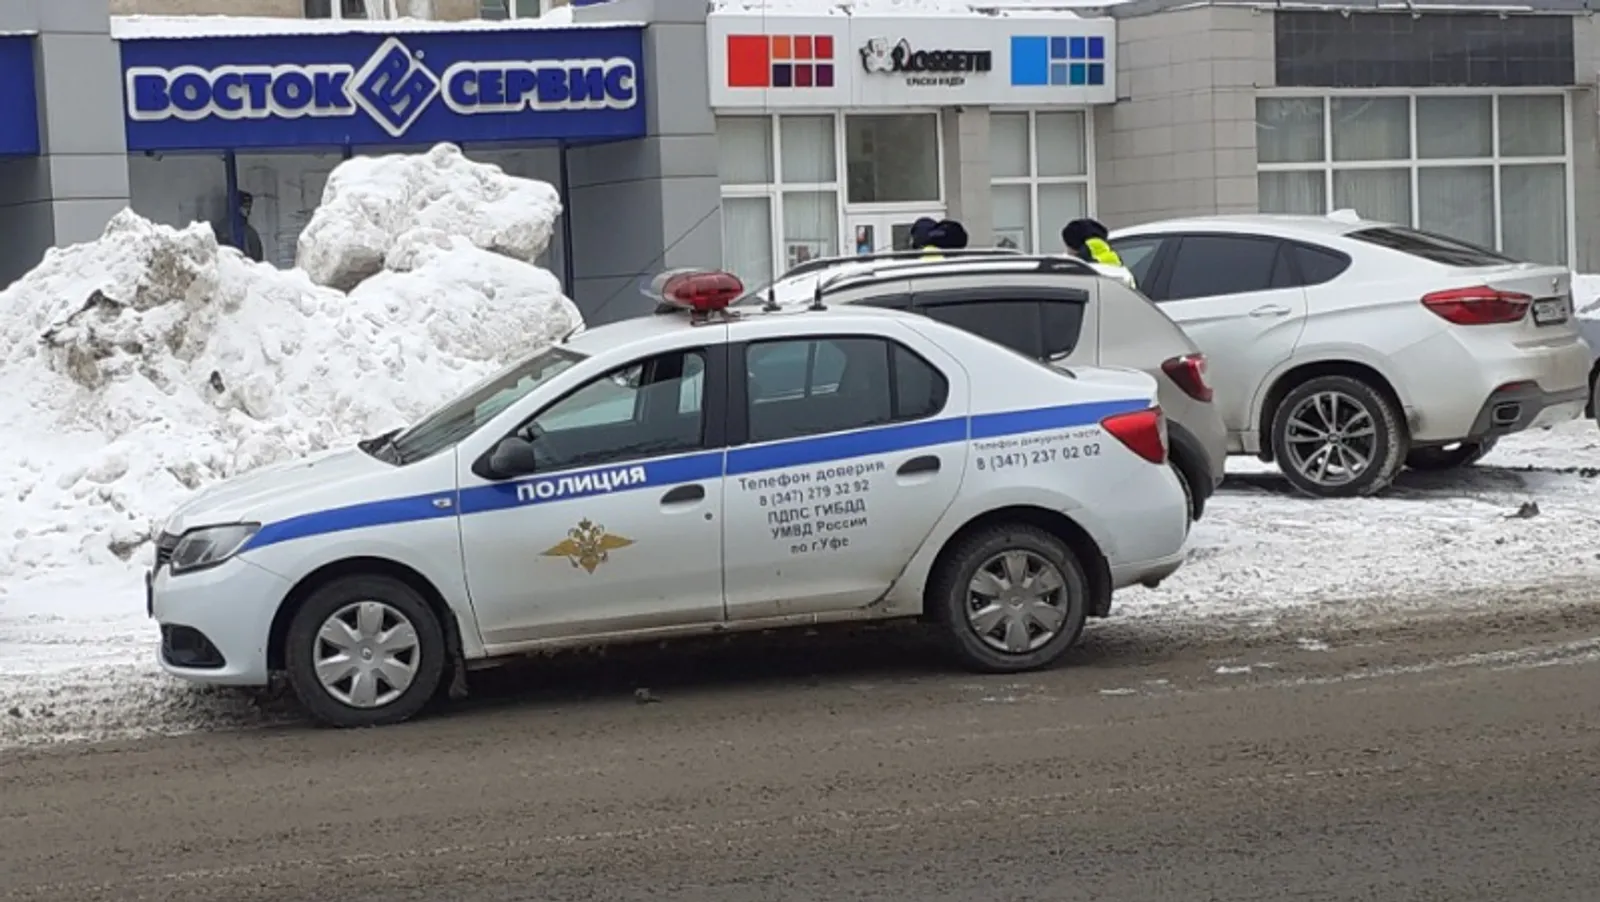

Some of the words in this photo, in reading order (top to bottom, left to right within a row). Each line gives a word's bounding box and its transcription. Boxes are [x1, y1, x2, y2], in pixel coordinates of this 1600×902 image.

[134, 72, 352, 111] ВОСТОК
[448, 64, 634, 106] СЕРВИС
[976, 457, 986, 471] 8
[990, 452, 1028, 472] (347)
[1031, 448, 1057, 464] 237
[1062, 446, 1079, 460] 02
[1083, 442, 1101, 457] 02
[516, 465, 648, 502] ПОЛИЦИЯ
[738, 472, 811, 491] Телефон
[815, 460, 886, 481] доверия
[759, 495, 768, 507] 8
[771, 491, 804, 507] (347)
[807, 485, 832, 501] 279
[834, 482, 851, 496] 32
[852, 479, 870, 493] 92
[767, 507, 810, 524] ПДПС
[814, 498, 867, 517] ГИБДД
[771, 522, 814, 540] УМВД
[816, 516, 869, 533] России
[790, 543, 808, 555] по
